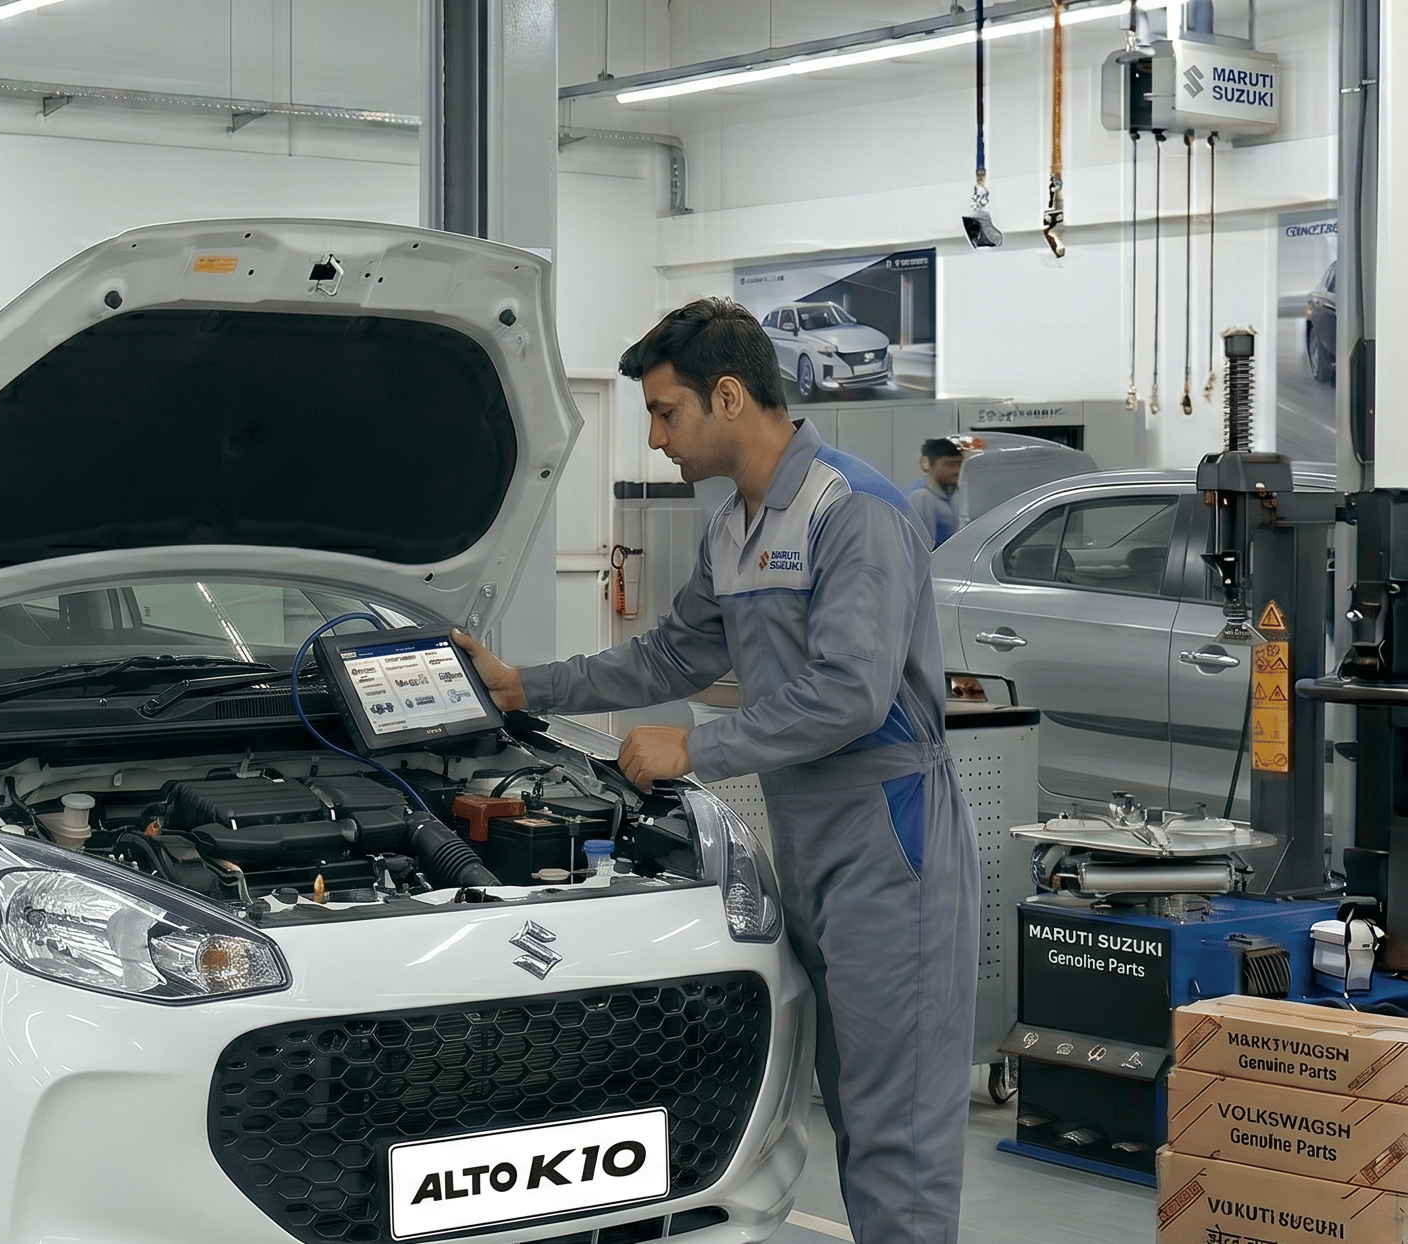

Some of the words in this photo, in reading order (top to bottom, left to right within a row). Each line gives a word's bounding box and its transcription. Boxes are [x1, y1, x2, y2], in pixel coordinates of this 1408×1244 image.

[1212, 67, 1273, 89] MARUTI
[1212, 85, 1273, 107] SUZUKI
[1029, 924, 1093, 947] MARUTI
[1097, 934, 1163, 957] SUZUKI
[1108, 958, 1145, 978] Parts
[1238, 1054, 1295, 1075] Genuine
[1299, 1062, 1337, 1082] Parts
[1217, 1102, 1351, 1139] VOLKSWAGSH
[1296, 1139, 1337, 1162] Parts
[410, 1161, 518, 1205] ALTO
[526, 1140, 647, 1190] K10
